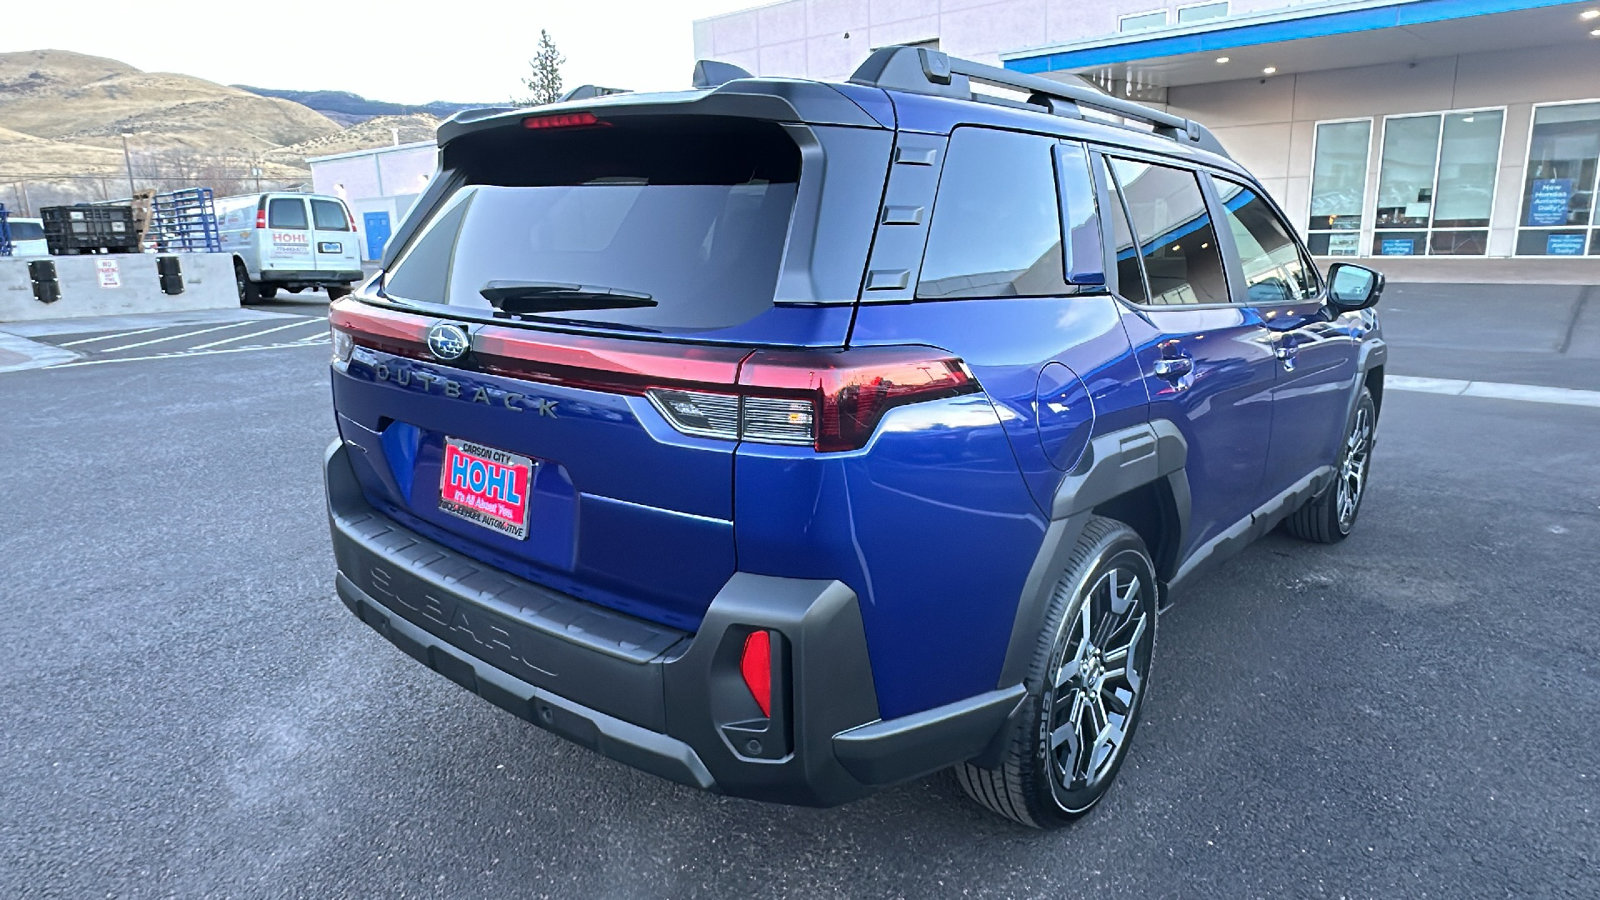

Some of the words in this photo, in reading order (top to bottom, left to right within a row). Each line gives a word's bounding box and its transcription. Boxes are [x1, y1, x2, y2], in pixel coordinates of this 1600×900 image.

[272, 233, 307, 242] HOHL
[376, 364, 559, 419] OUTBACK
[463, 443, 492, 459] CARSON
[493, 452, 512, 464] CITY
[451, 454, 520, 504] HOHL
[466, 493, 476, 506] All
[475, 496, 498, 513] About
[498, 502, 513, 518] You
